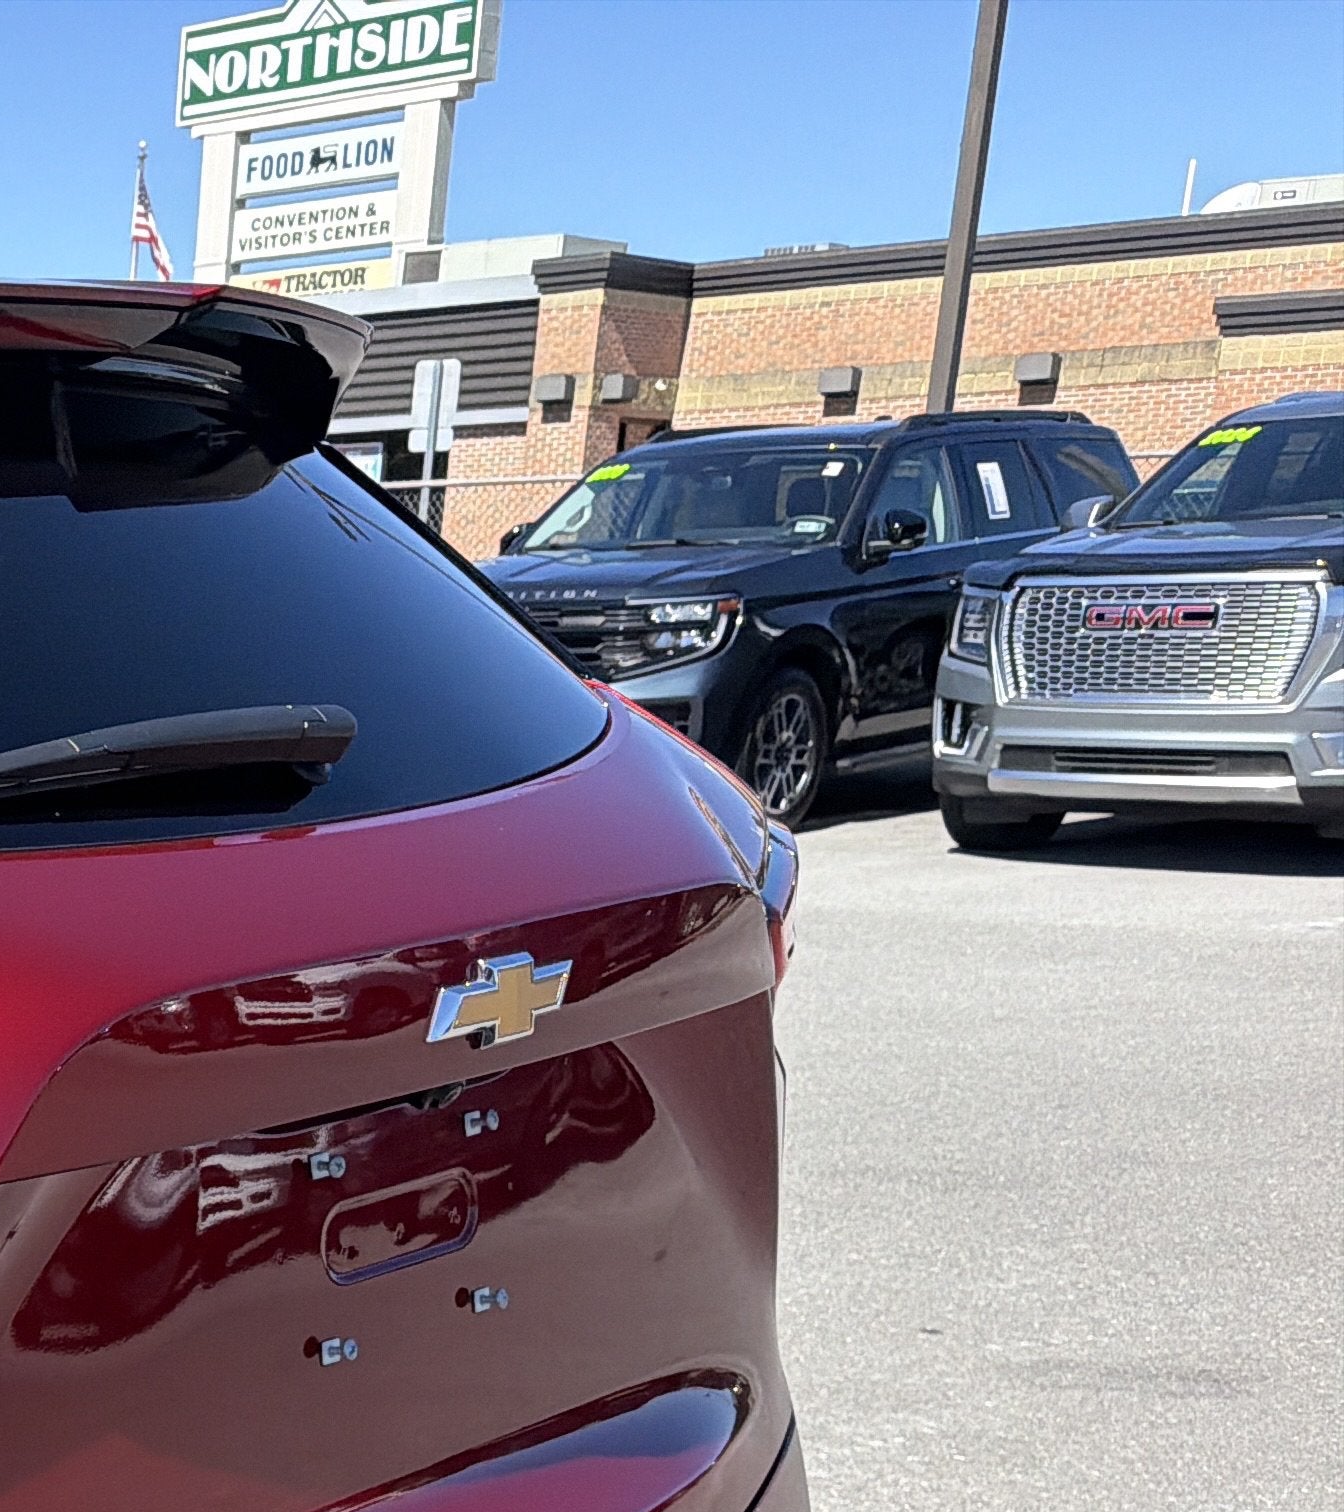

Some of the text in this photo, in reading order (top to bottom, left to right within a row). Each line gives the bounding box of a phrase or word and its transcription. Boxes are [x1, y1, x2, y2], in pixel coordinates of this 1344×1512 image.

[183, 7, 473, 100] NORTHSIDE
[246, 136, 396, 183] FOOD LION
[251, 202, 377, 233] CONVENTION &
[238, 220, 391, 252] VISITOR'S CENTER
[283, 267, 367, 293] TRACTOR
[1085, 604, 1216, 629] GMC
